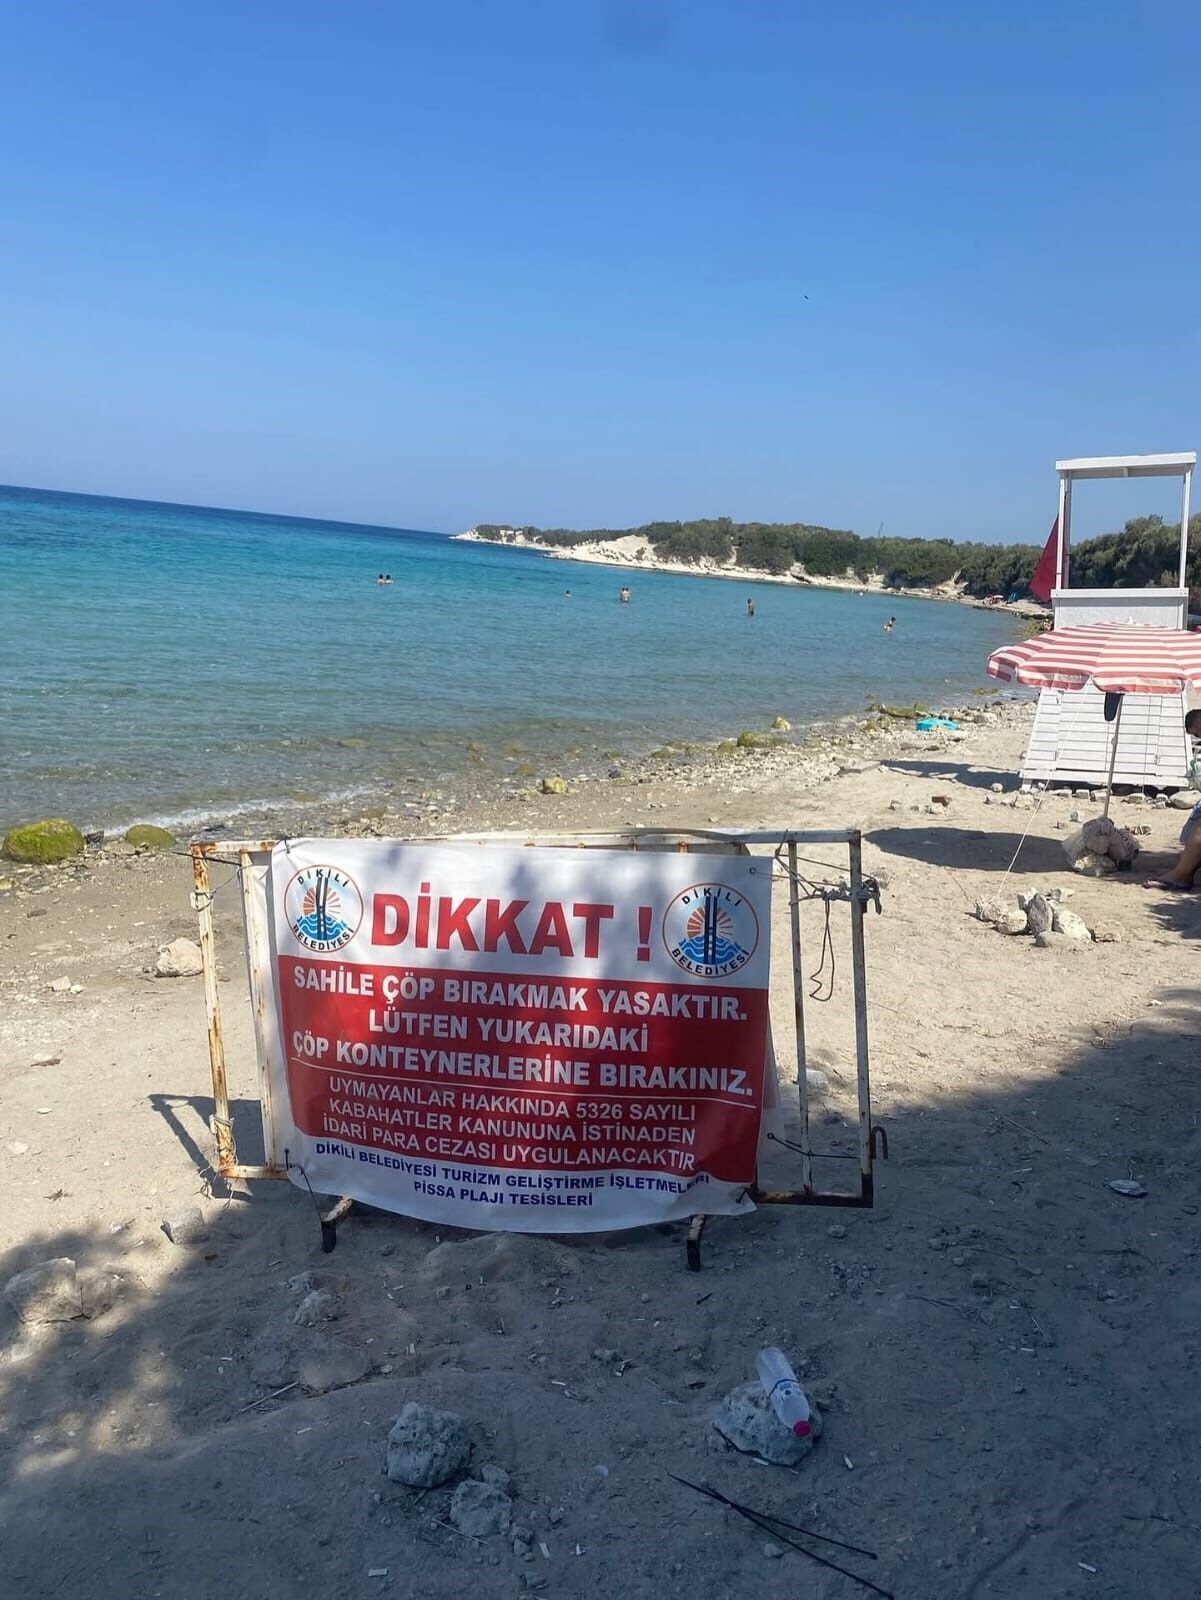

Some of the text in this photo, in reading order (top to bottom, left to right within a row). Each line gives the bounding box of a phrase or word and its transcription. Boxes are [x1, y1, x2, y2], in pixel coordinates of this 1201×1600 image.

[371, 882, 652, 962] DİKKAT !
[294, 965, 748, 1021] SAHİLE ÇÖP BIRAKMAK YASAKTIR.
[369, 1006, 649, 1052] LÜTFEN YUKARIDAKİ
[293, 1030, 753, 1096] ÇÖP KONTEYNERLERİNE BIRAKINIZ.
[330, 1076, 696, 1121] UYMAYANLAR HAKKINDA 5326 SAYILI
[330, 1098, 696, 1145] KABAHATLER KANUNUNA İSTİNADEN
[323, 1112, 695, 1171] İDARİ PARA CEZASI UYGULANACAKTIR
[316, 1143, 355, 1160] DİKİLİ
[359, 1151, 437, 1177] BELEDİYESİ
[441, 1168, 500, 1186] TURİZM
[505, 1173, 605, 1191] GELİŞTİRME
[414, 1180, 593, 1206] PİSSA PLAJI TESİSLERİ
